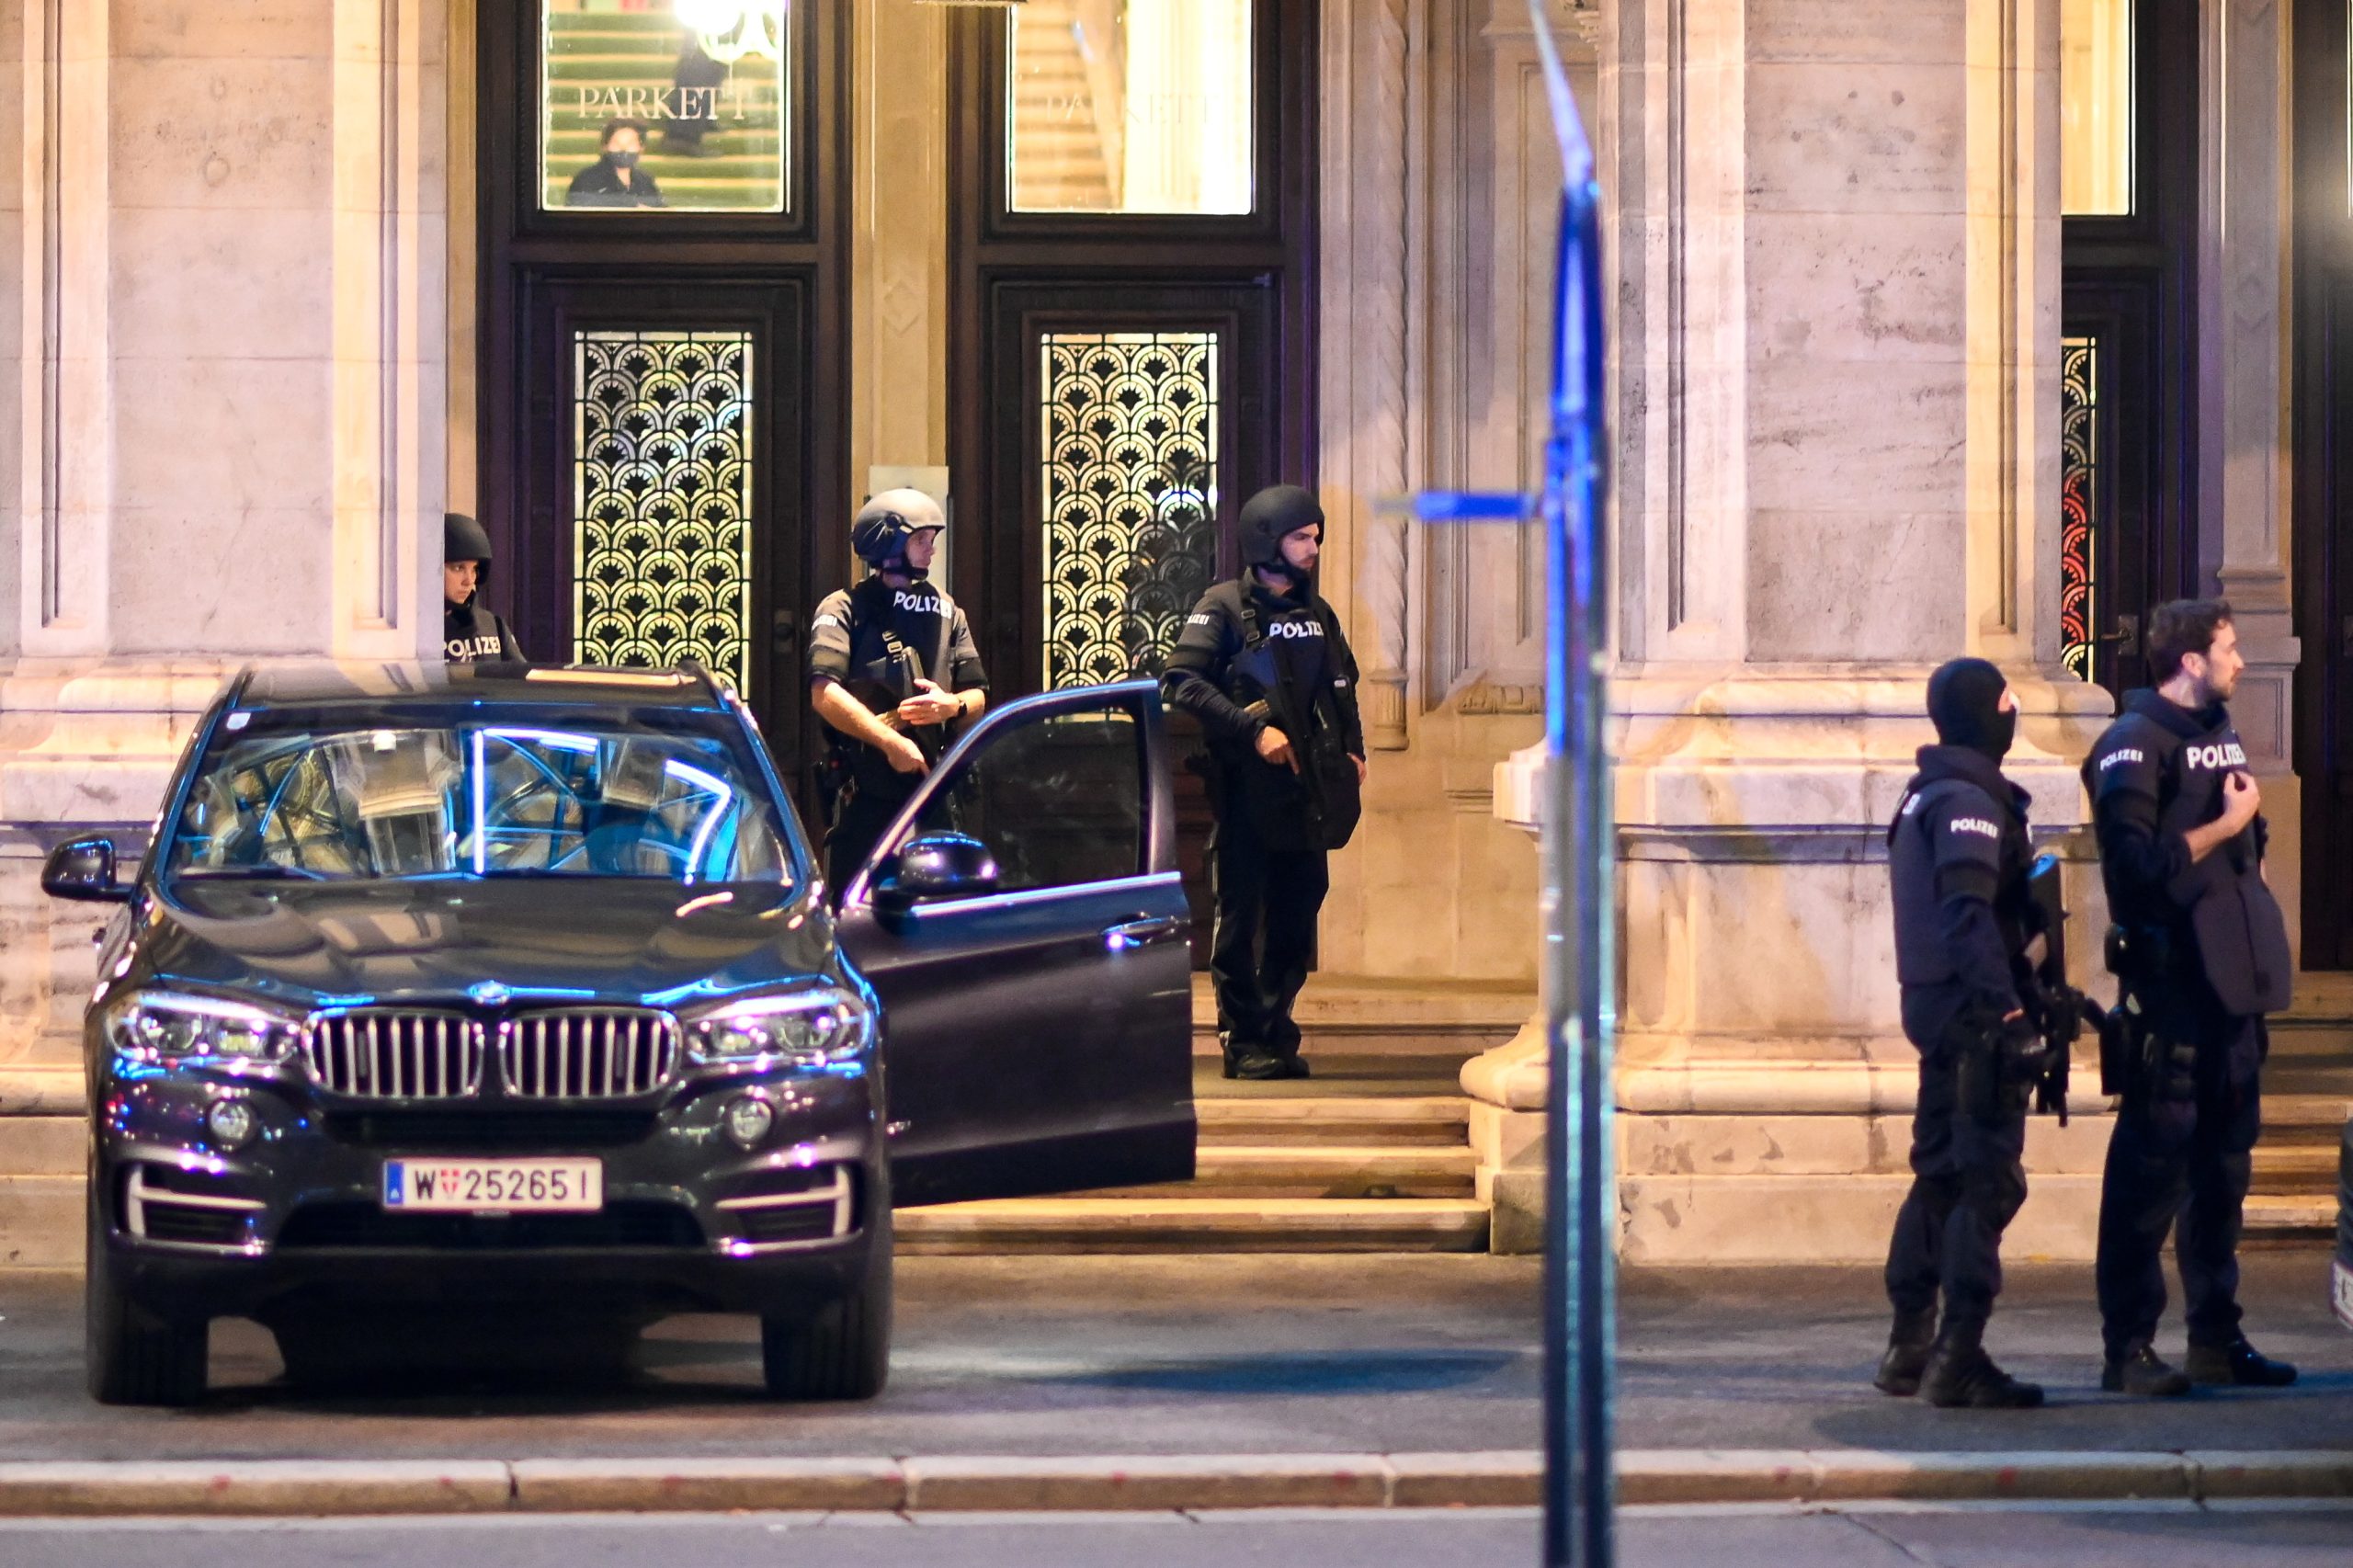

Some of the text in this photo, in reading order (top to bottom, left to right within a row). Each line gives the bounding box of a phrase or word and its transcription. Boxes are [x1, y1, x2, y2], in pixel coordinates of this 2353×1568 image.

[578, 86, 751, 120] PARKETT
[2100, 748, 2143, 771] POLIZEI
[415, 1169, 437, 1200] W
